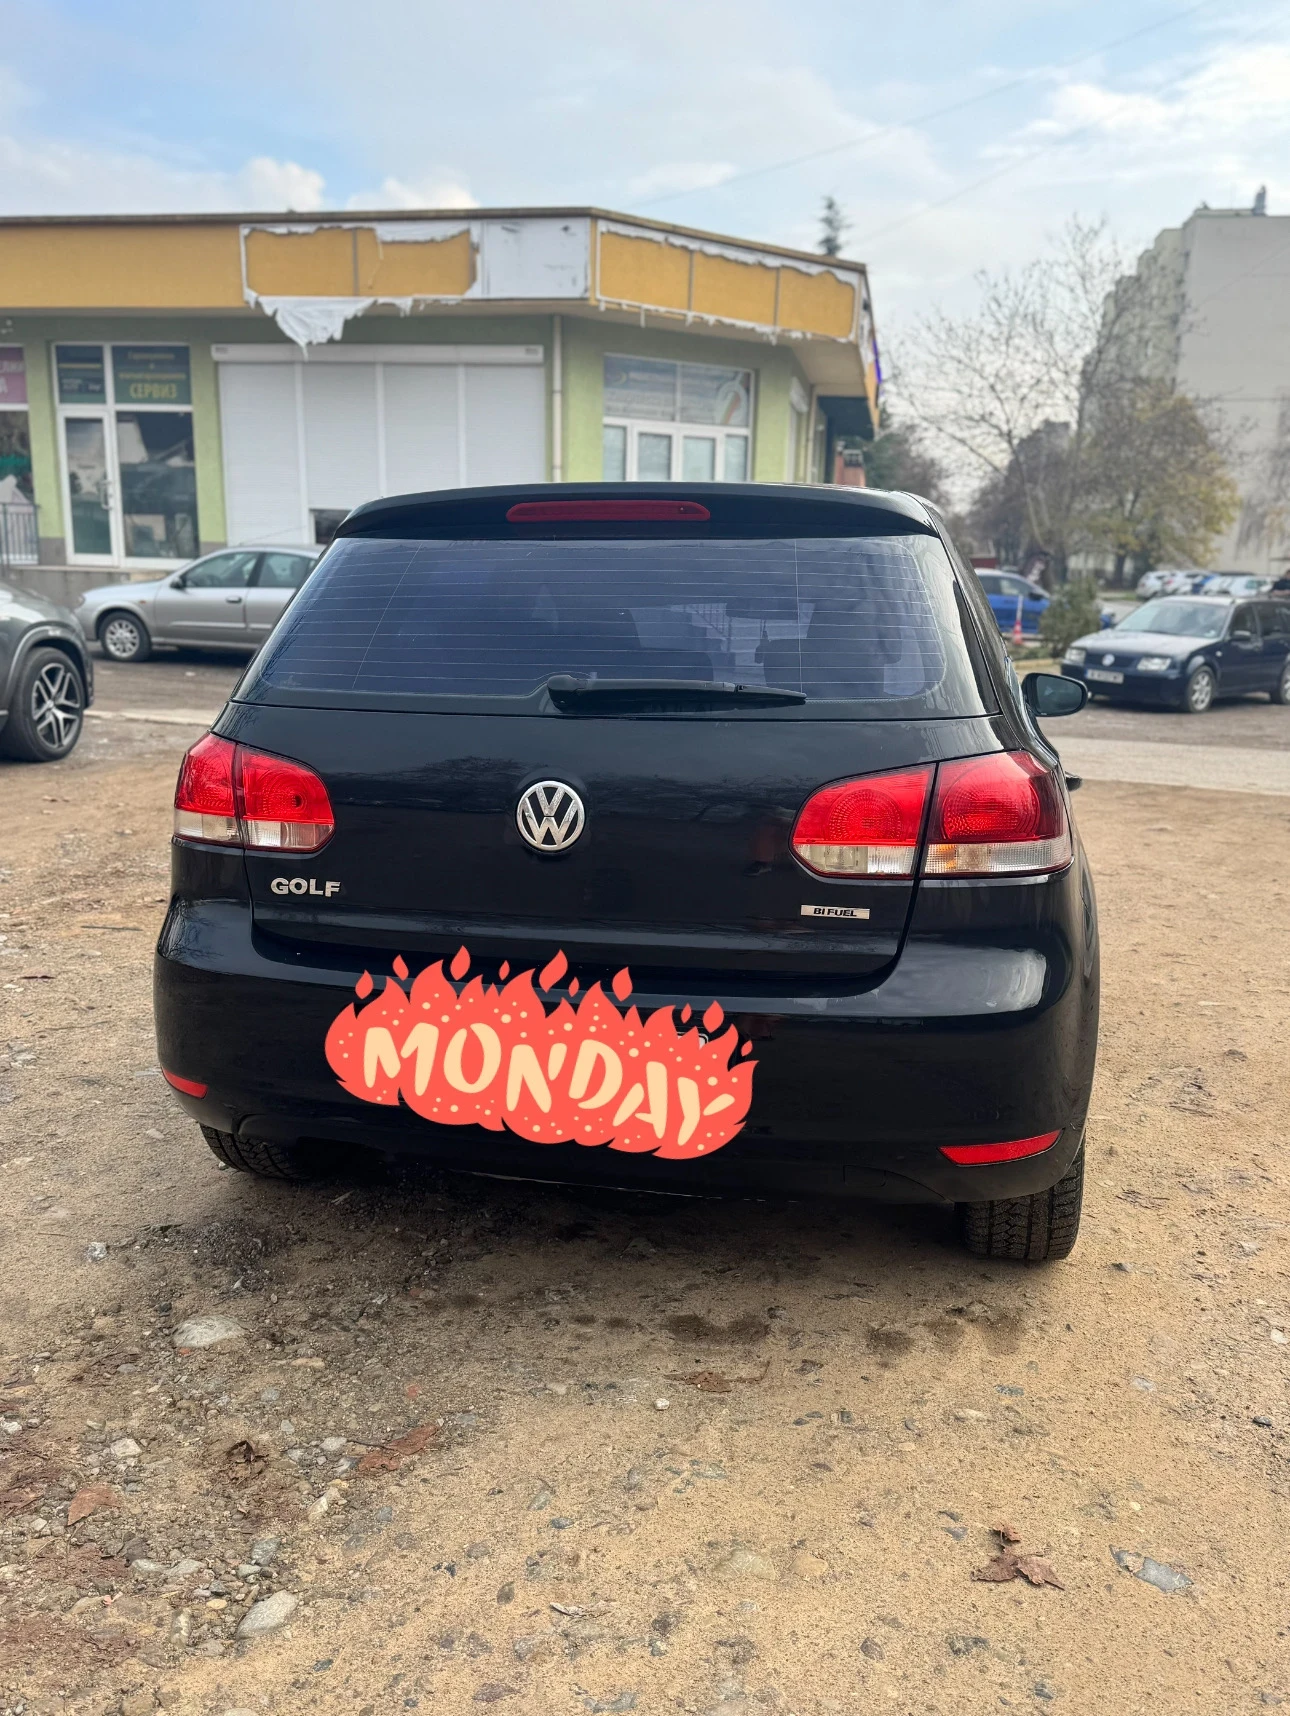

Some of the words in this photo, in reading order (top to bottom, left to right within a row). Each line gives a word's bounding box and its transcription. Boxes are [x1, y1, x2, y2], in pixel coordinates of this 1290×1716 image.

[129, 383, 177, 399] СЕРВИЗ
[270, 877, 341, 897] GOLF
[827, 908, 857, 917] FUEL
